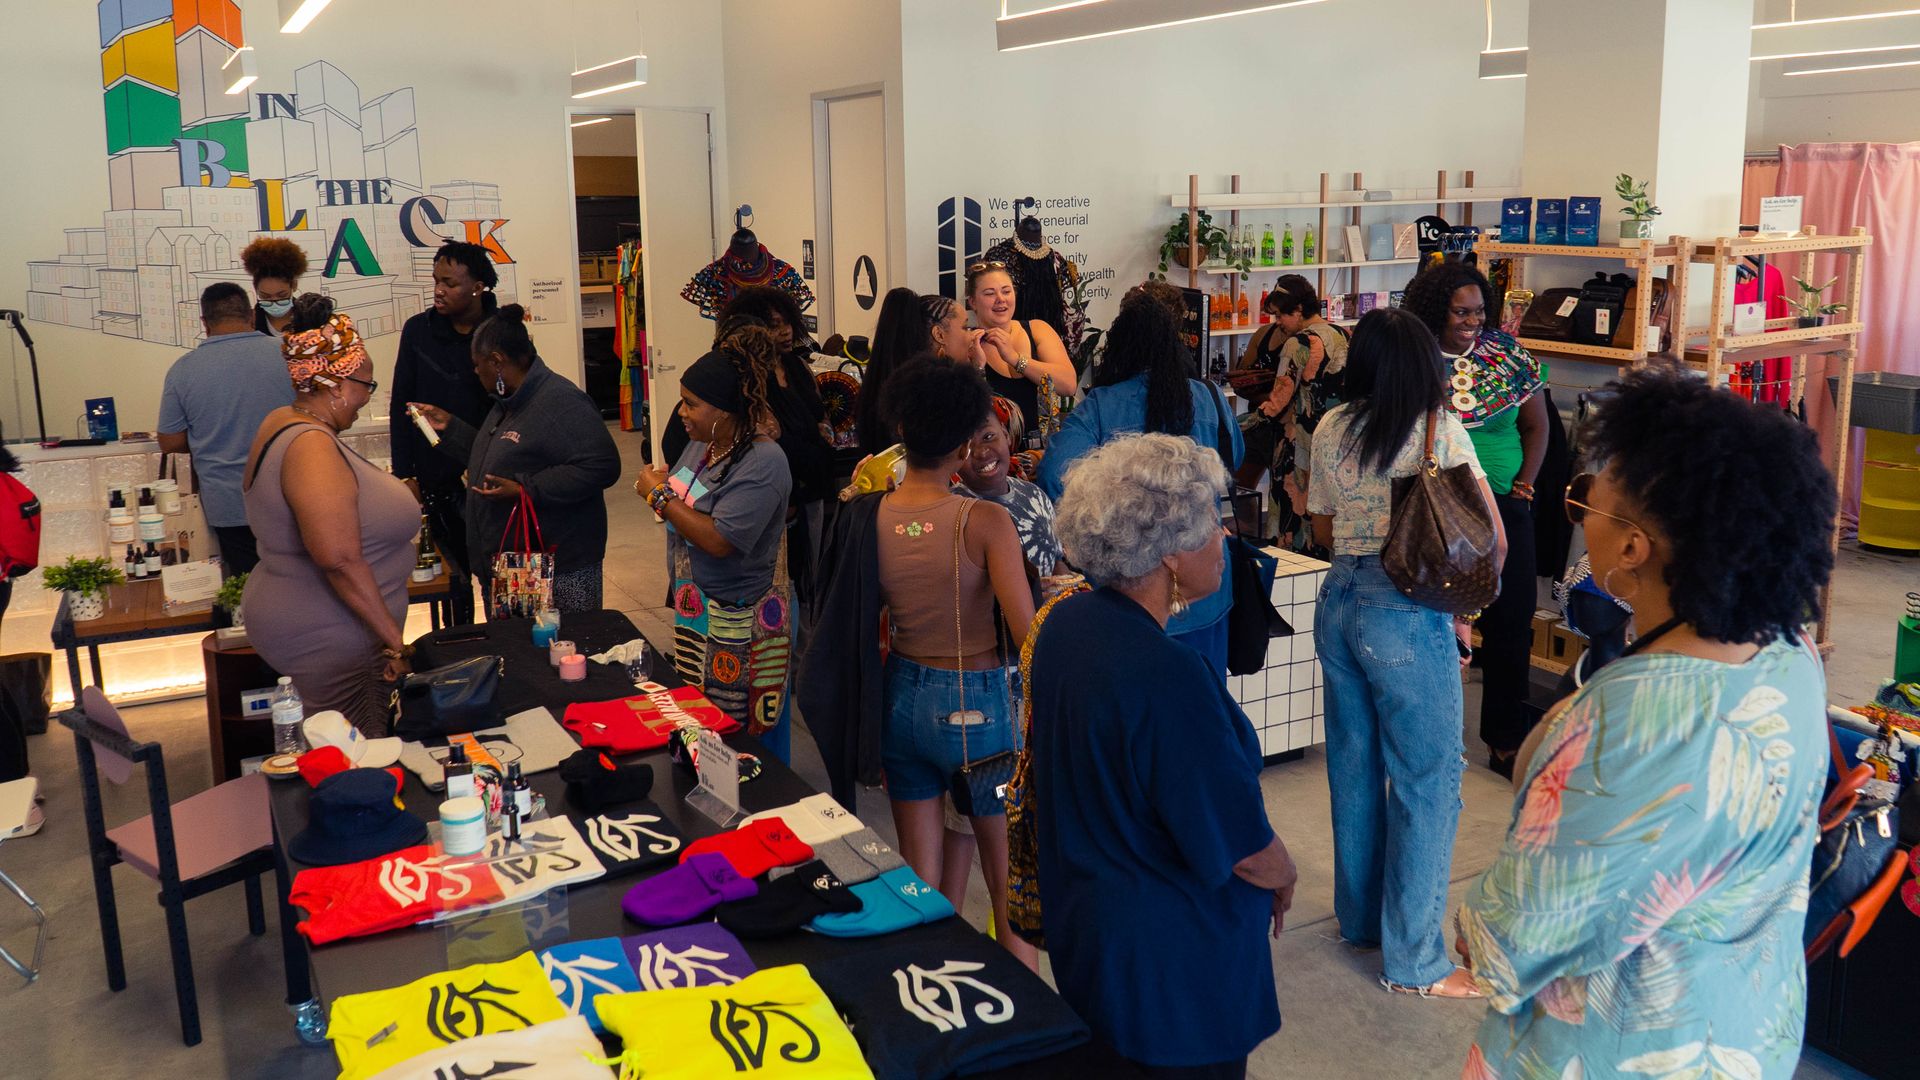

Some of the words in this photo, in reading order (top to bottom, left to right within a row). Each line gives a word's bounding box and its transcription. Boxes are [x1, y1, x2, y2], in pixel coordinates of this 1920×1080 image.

[256, 93, 298, 119] IN
[316, 179, 393, 206] THE
[989, 198, 1008, 210] We
[1035, 200, 1042, 208] a
[1045, 196, 1090, 208] creative
[989, 217, 998, 228] &
[1002, 214, 1088, 228] enreneurial
[1064, 232, 1079, 244] for
[1420, 221, 1440, 241] fc
[1079, 267, 1115, 280] wealth
[1062, 286, 1113, 300] roperity.
